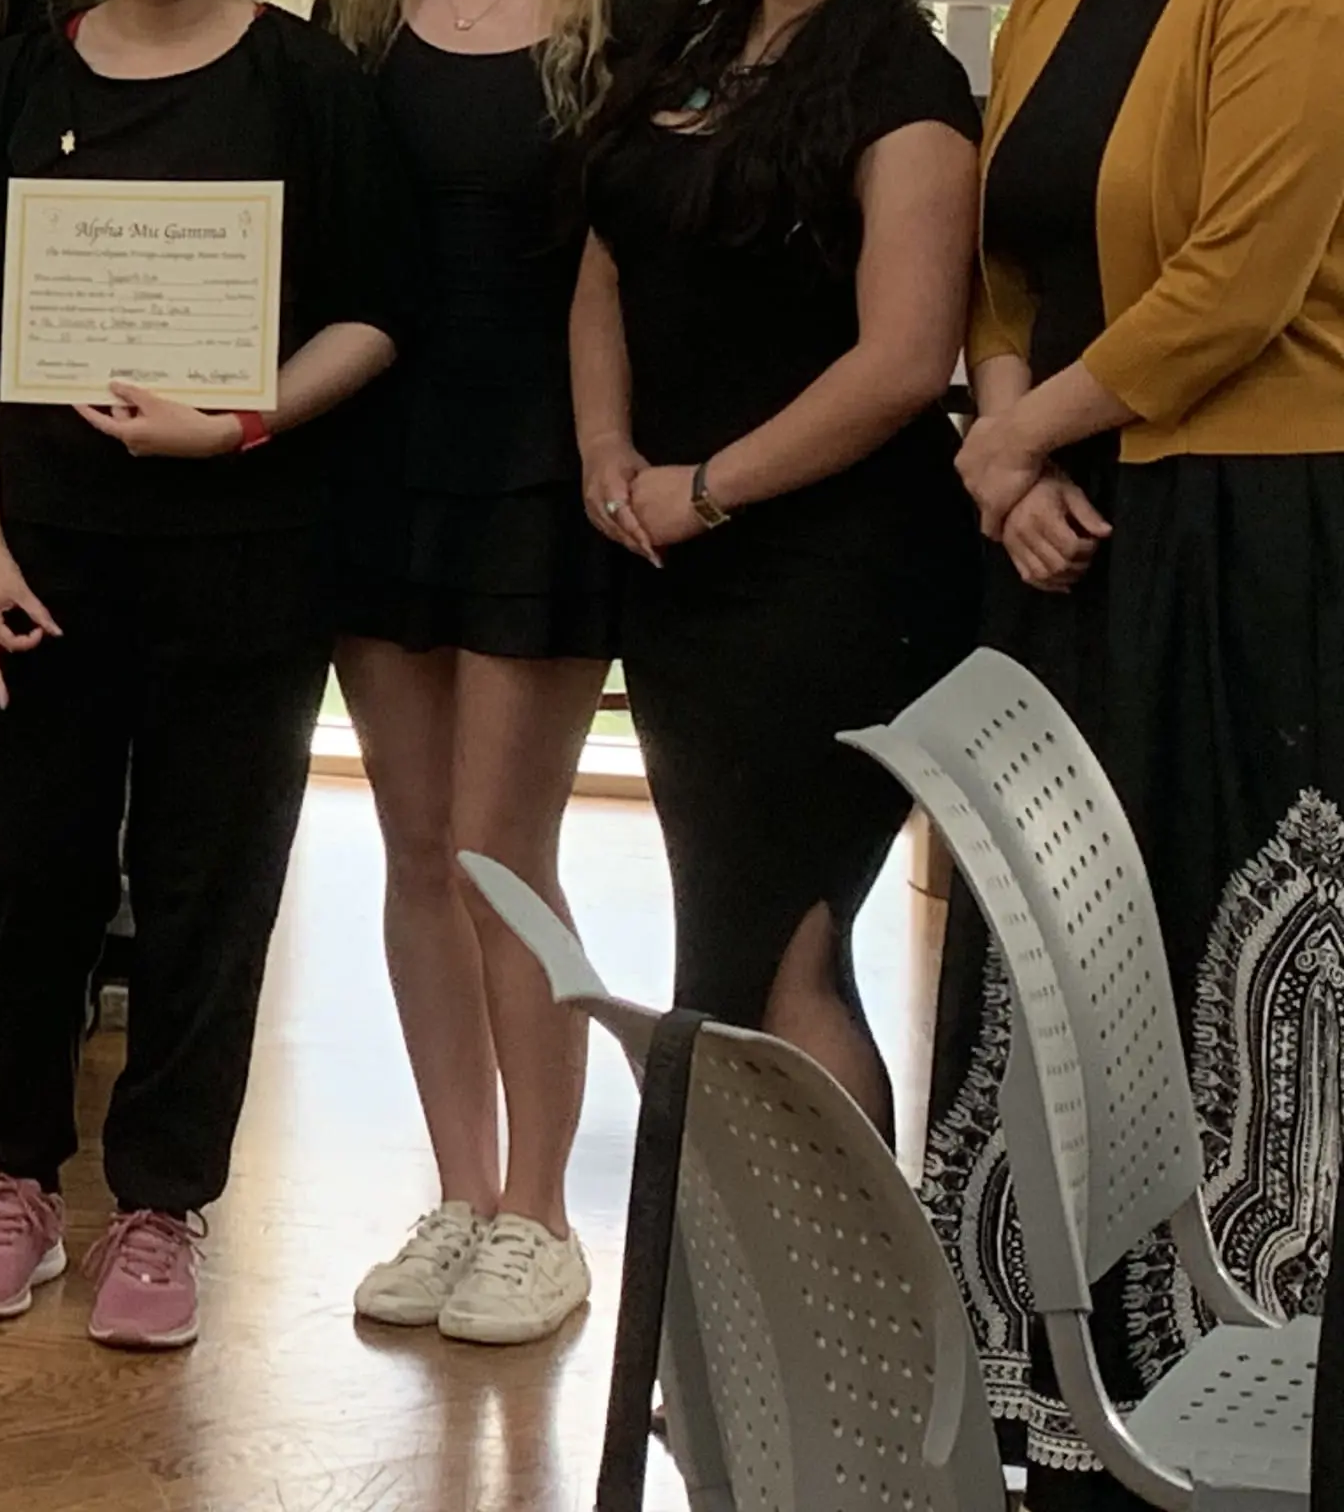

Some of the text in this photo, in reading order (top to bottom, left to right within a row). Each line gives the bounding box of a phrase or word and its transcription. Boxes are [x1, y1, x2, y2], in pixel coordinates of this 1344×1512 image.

[75, 217, 227, 246] Alpha Mu Gamma
